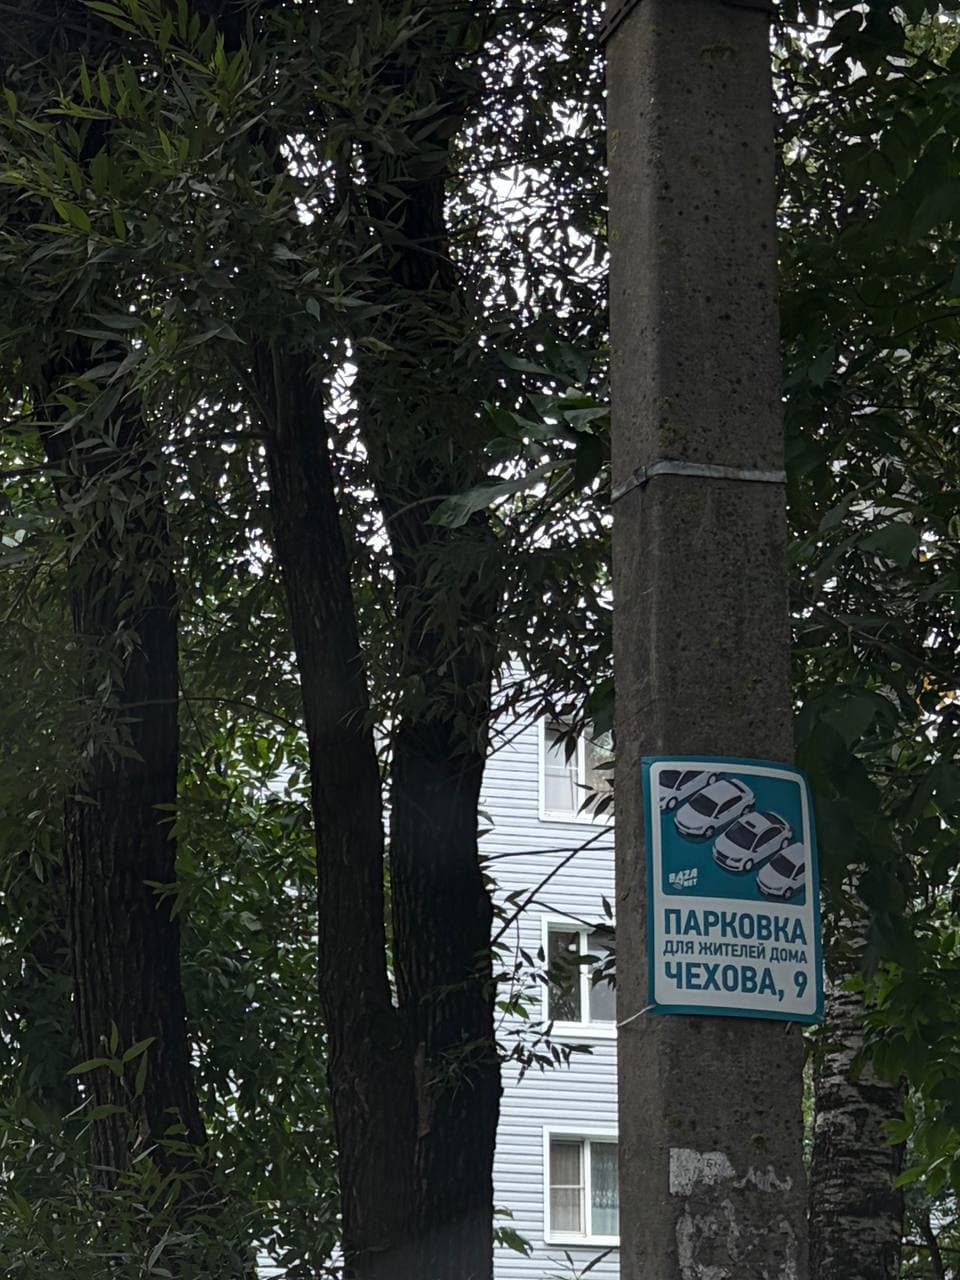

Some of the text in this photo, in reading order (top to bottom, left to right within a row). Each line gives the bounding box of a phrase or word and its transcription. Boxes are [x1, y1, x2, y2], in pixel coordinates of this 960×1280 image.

[664, 908, 808, 946] ПАРКОВКА
[663, 940, 808, 964] ДЛЯ ЖИТЕЛЕЙ ДОМА
[664, 961, 808, 1002] ЧЕХОВА, 9
